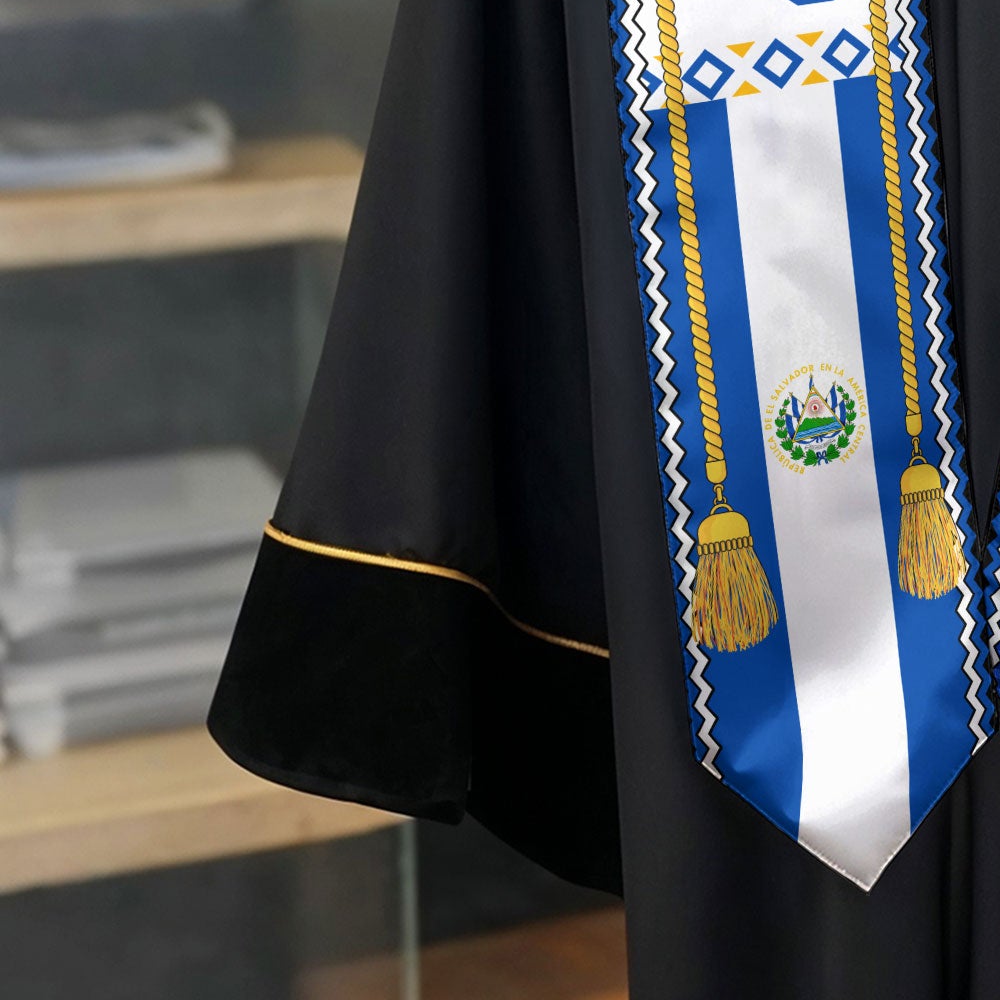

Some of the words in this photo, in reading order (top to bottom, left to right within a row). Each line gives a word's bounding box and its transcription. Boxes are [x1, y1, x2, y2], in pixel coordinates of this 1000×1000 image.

[820, 363, 832, 372] EN
[833, 366, 845, 377] LA
[771, 364, 814, 400] SALVADOR
[765, 404, 775, 416] EL
[764, 418, 773, 431] DE
[840, 424, 866, 464] CENTRAL
